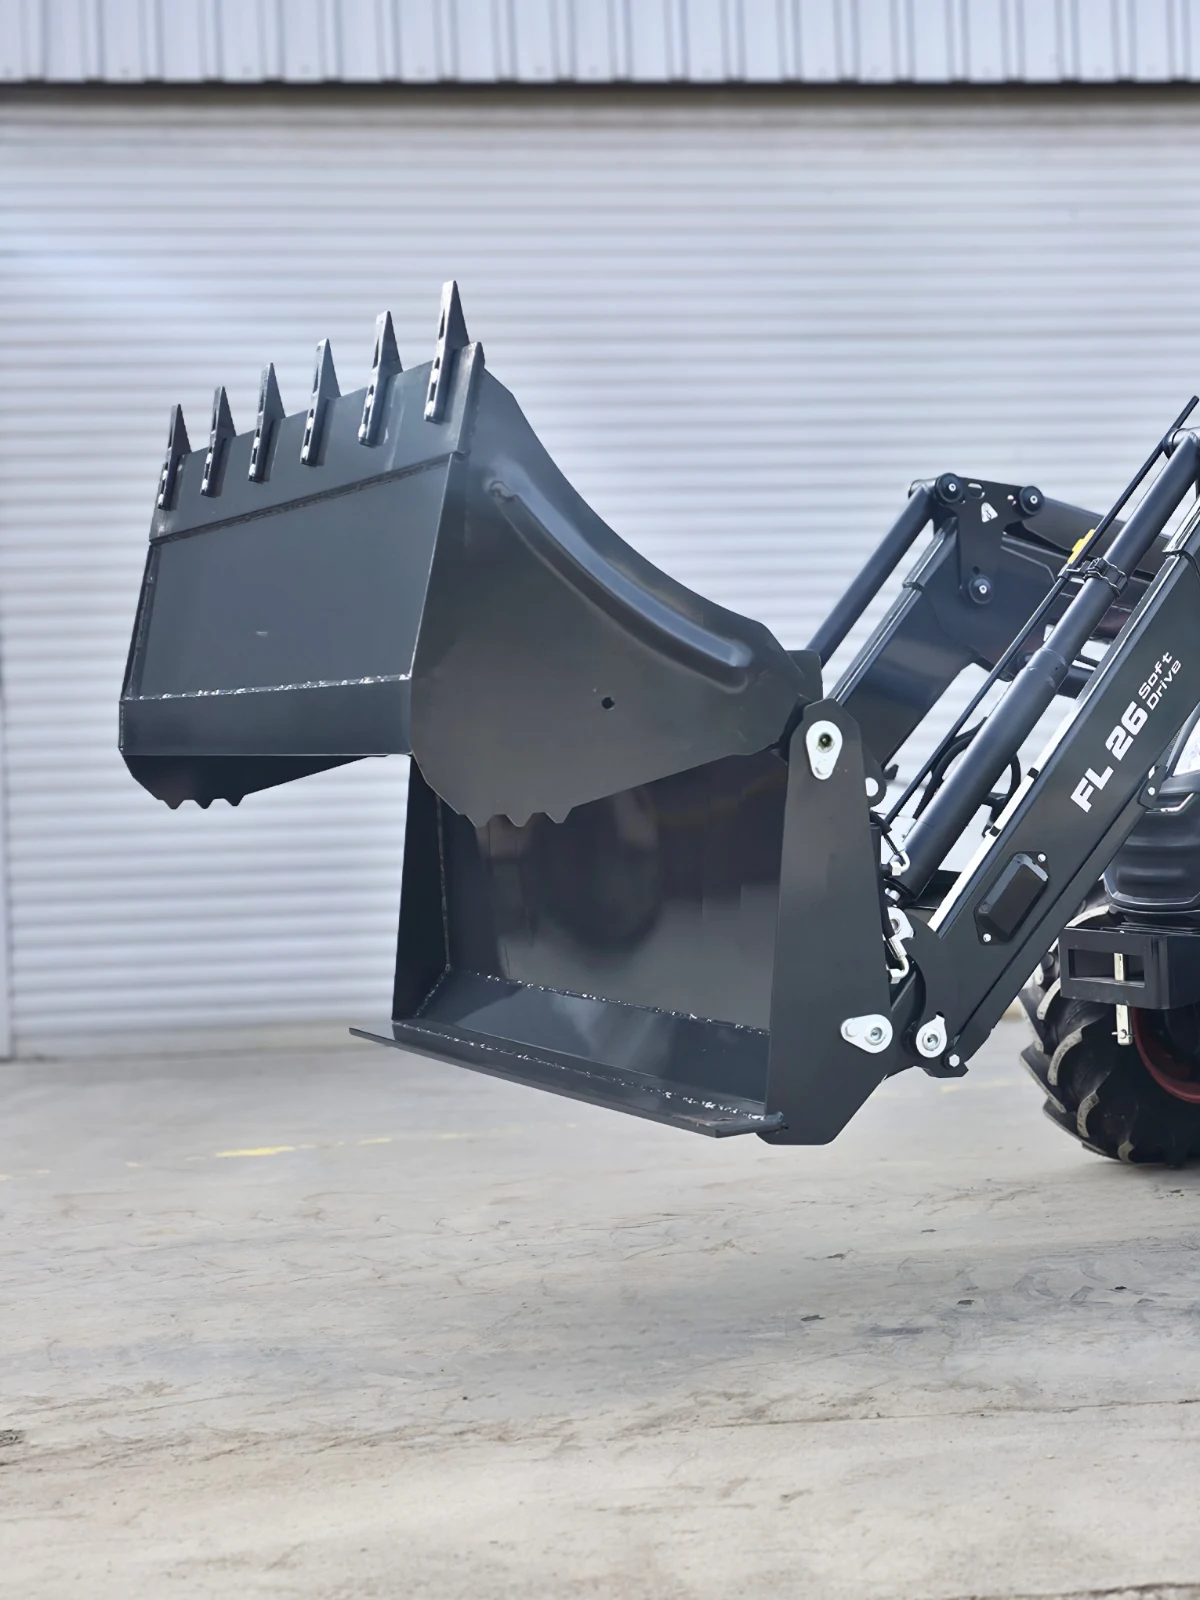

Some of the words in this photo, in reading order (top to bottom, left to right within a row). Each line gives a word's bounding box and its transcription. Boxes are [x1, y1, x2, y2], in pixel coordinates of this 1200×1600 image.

[1138, 652, 1172, 699] Soft
[1146, 660, 1182, 711] Drive
[1070, 766, 1114, 813] FL
[1105, 701, 1148, 761] 26
